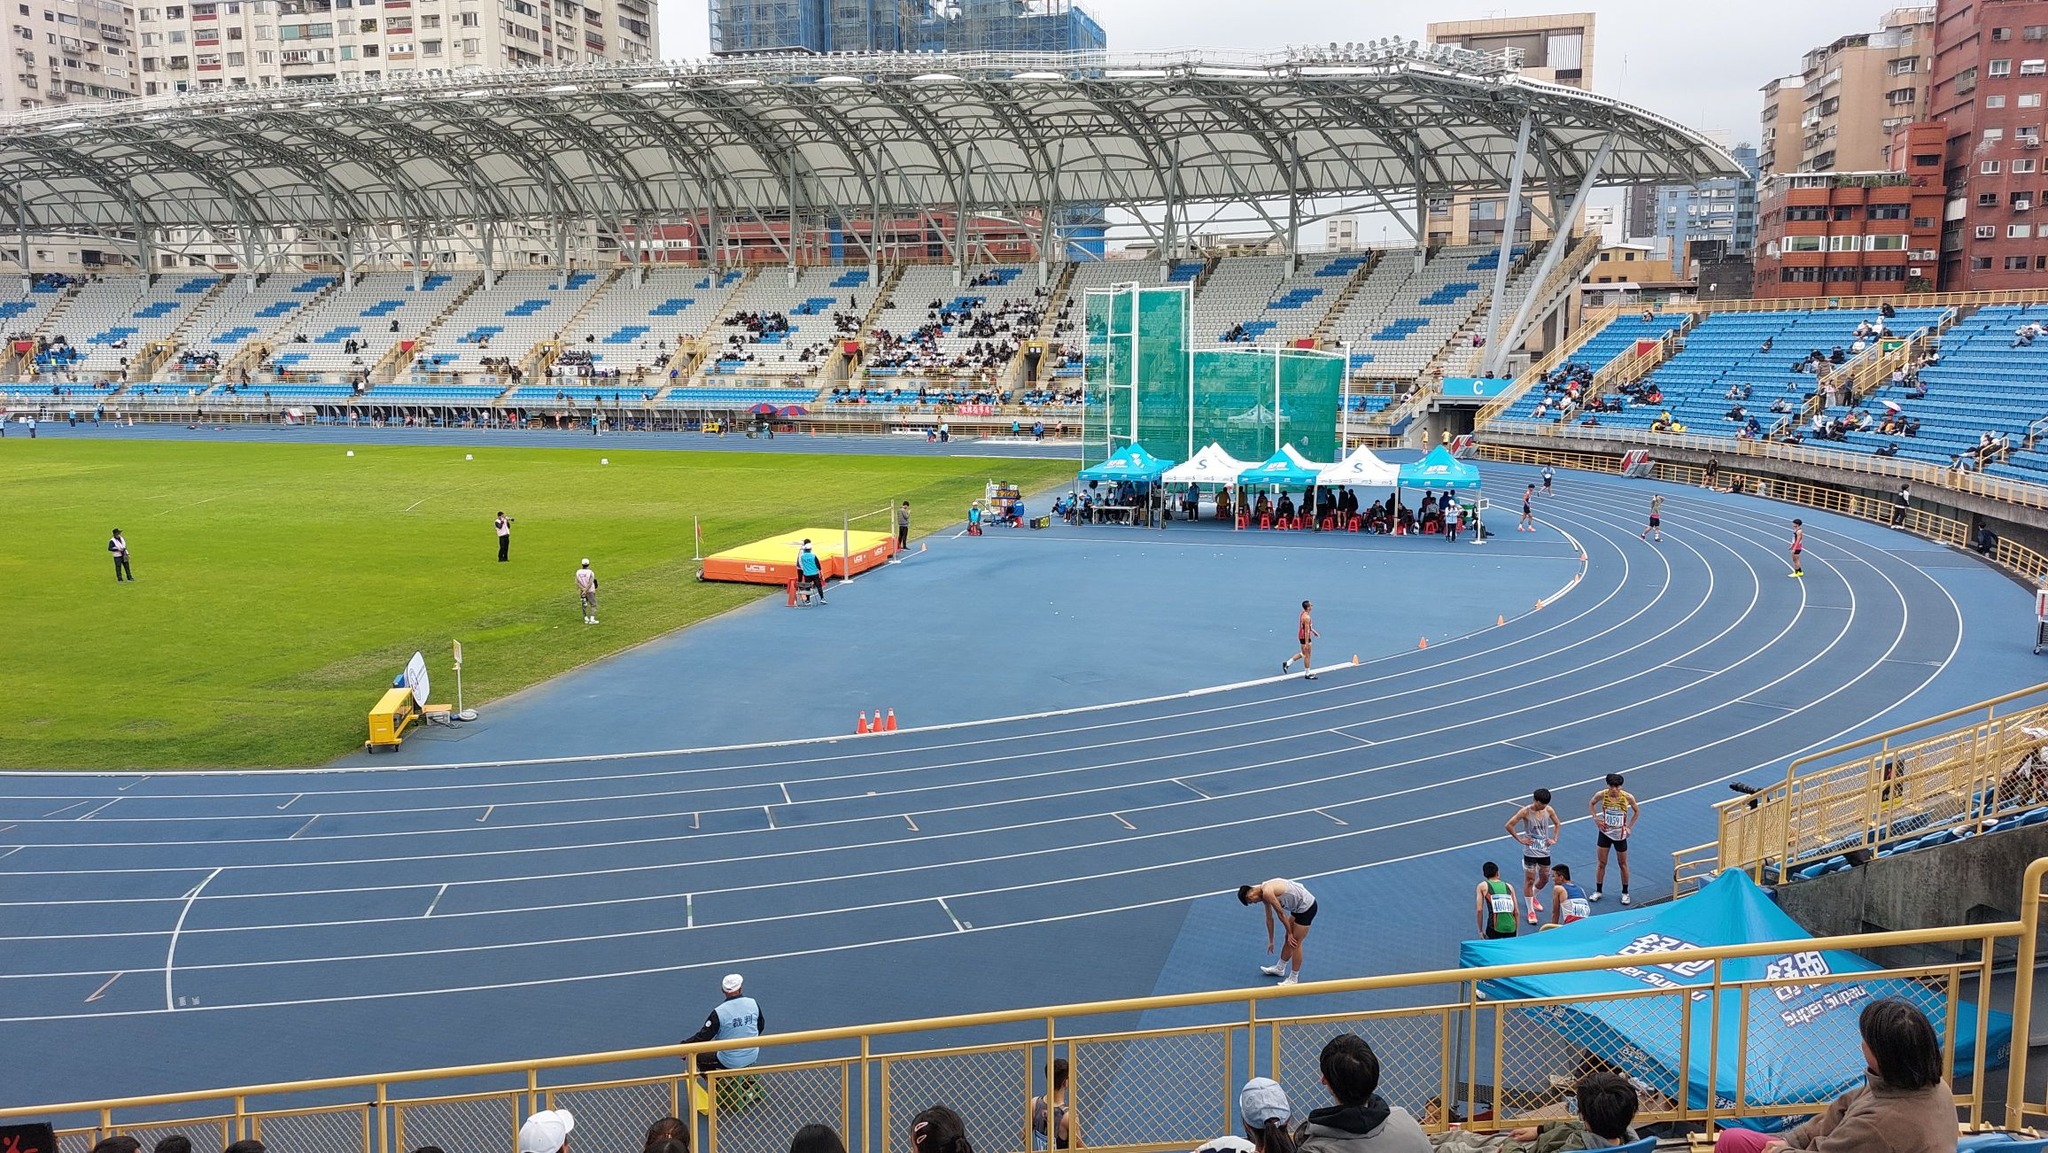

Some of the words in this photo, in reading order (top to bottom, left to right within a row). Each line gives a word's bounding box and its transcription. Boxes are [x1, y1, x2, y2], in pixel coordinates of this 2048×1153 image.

[1473, 380, 1484, 395] C
[1781, 1001, 1824, 1027] Super
[1823, 985, 1867, 1009] Supau
[732, 1014, 753, 1028] 裁判
